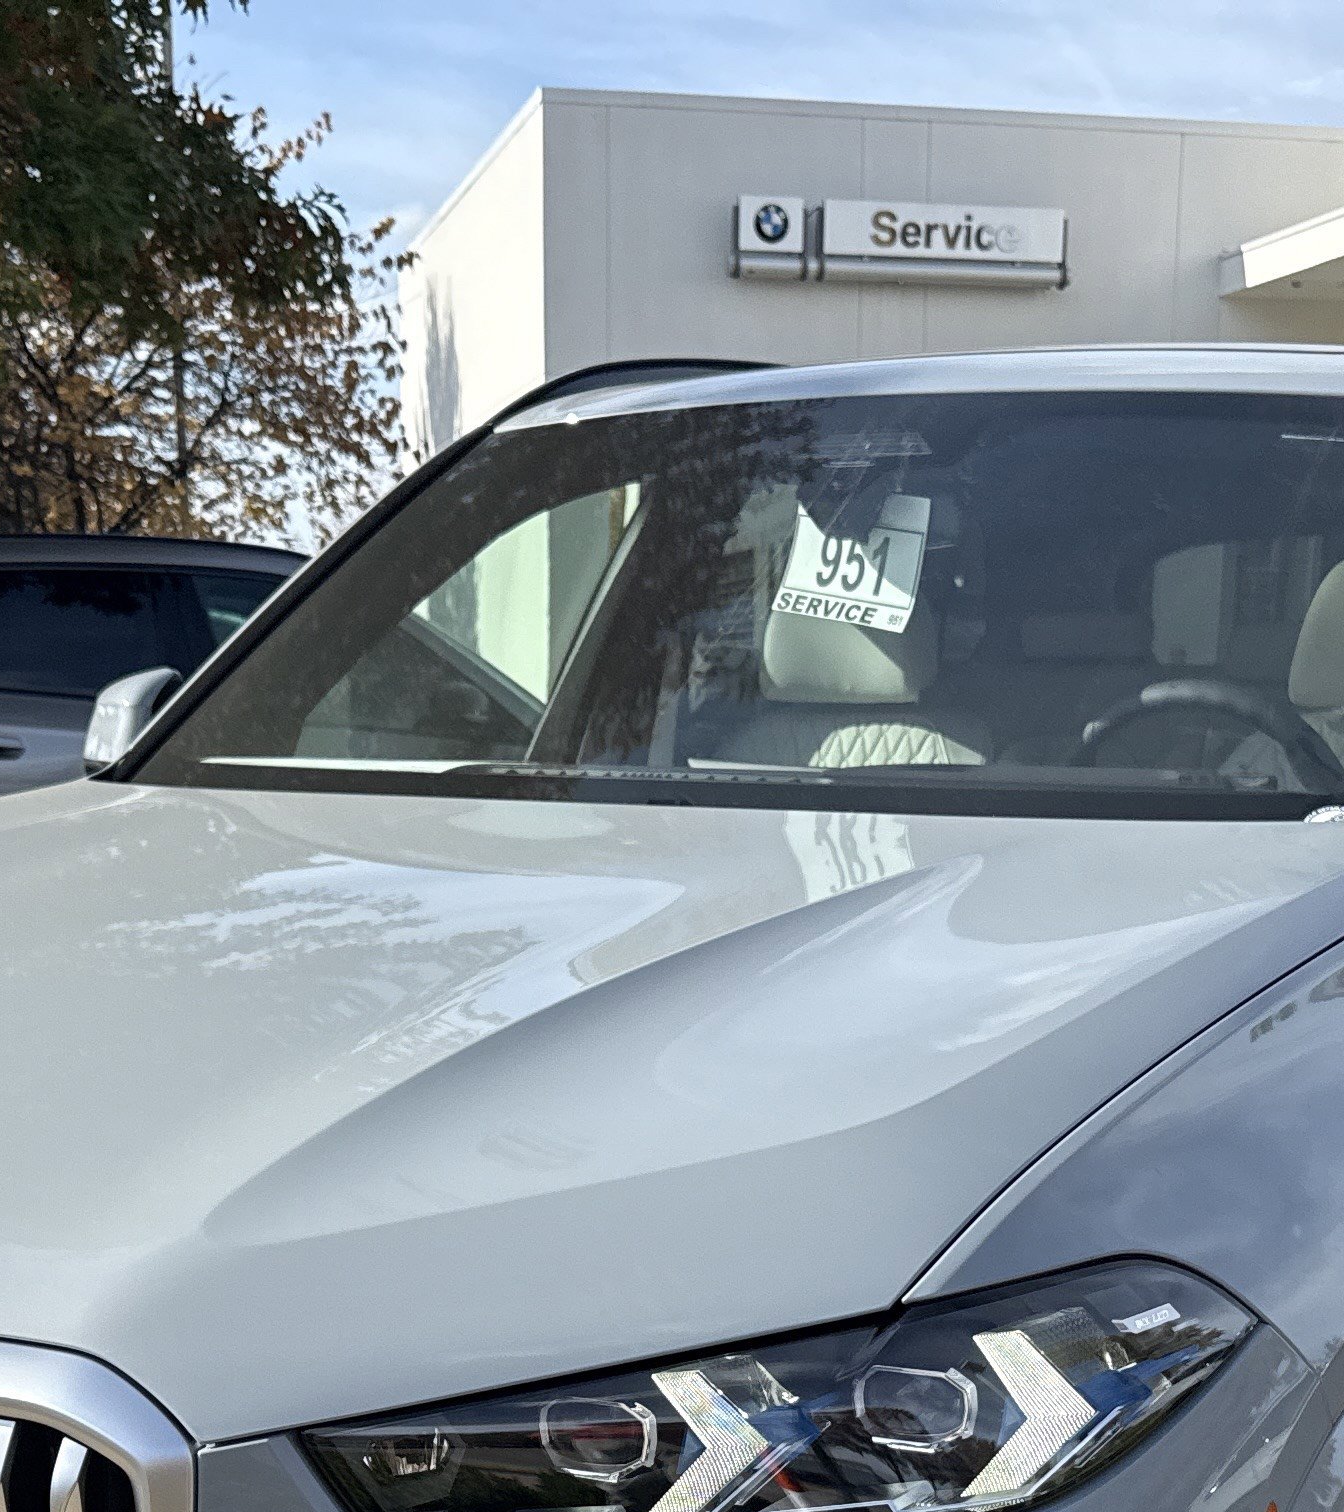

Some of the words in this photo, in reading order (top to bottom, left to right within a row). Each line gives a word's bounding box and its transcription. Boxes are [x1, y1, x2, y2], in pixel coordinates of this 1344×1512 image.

[871, 209, 1021, 254] Service
[816, 536, 890, 596] 951
[777, 593, 878, 624] SERVICE
